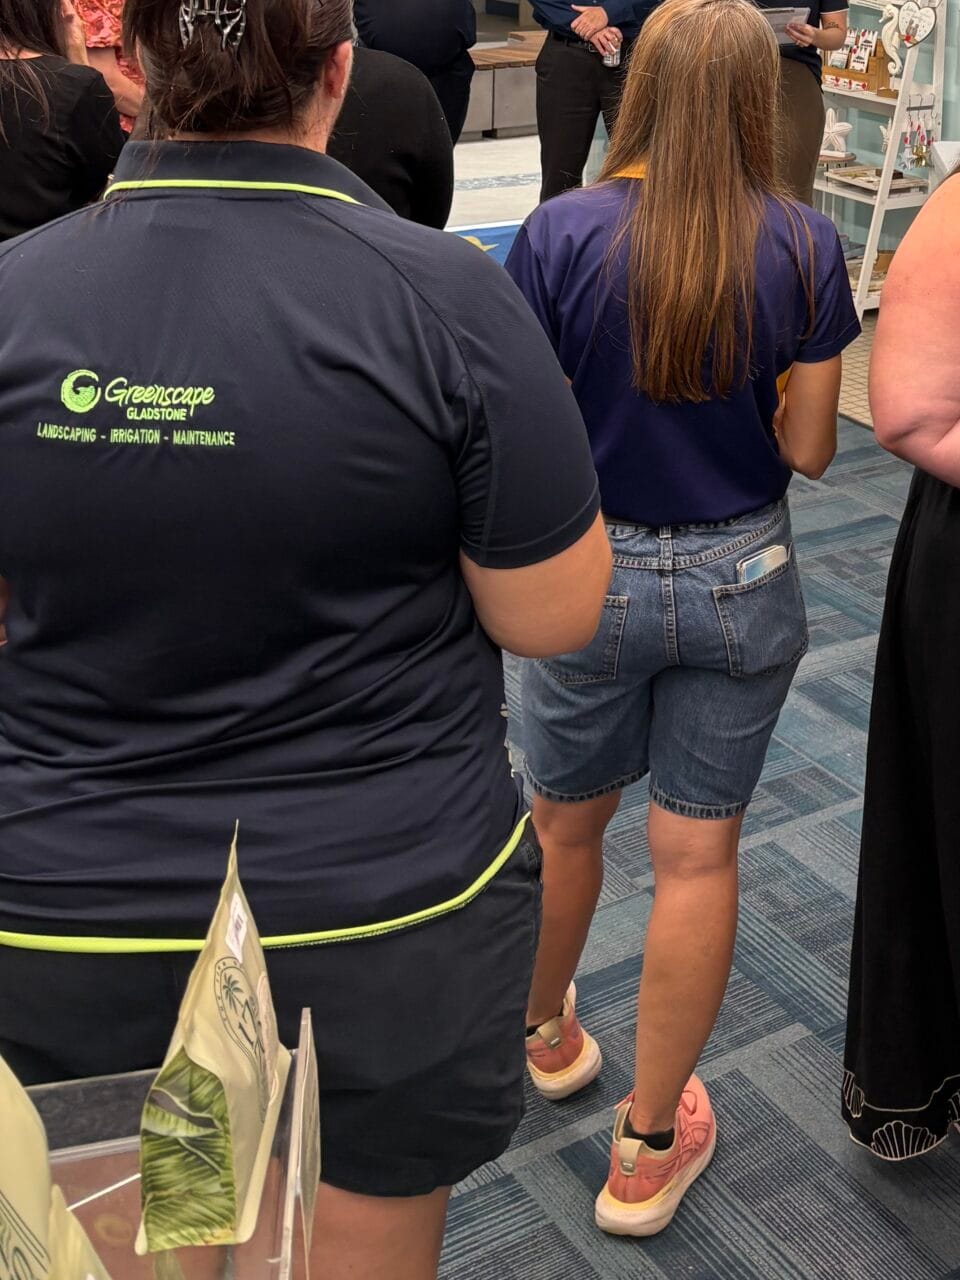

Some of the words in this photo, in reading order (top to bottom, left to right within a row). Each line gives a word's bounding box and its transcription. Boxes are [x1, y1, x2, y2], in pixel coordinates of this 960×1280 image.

[104, 376, 216, 418] Greenscape
[126, 407, 188, 421] GLADSTONE
[37, 422, 97, 443] LANDSCAPING
[110, 428, 160, 444] IRRIGATION
[173, 430, 236, 446] MAINTENANCE
